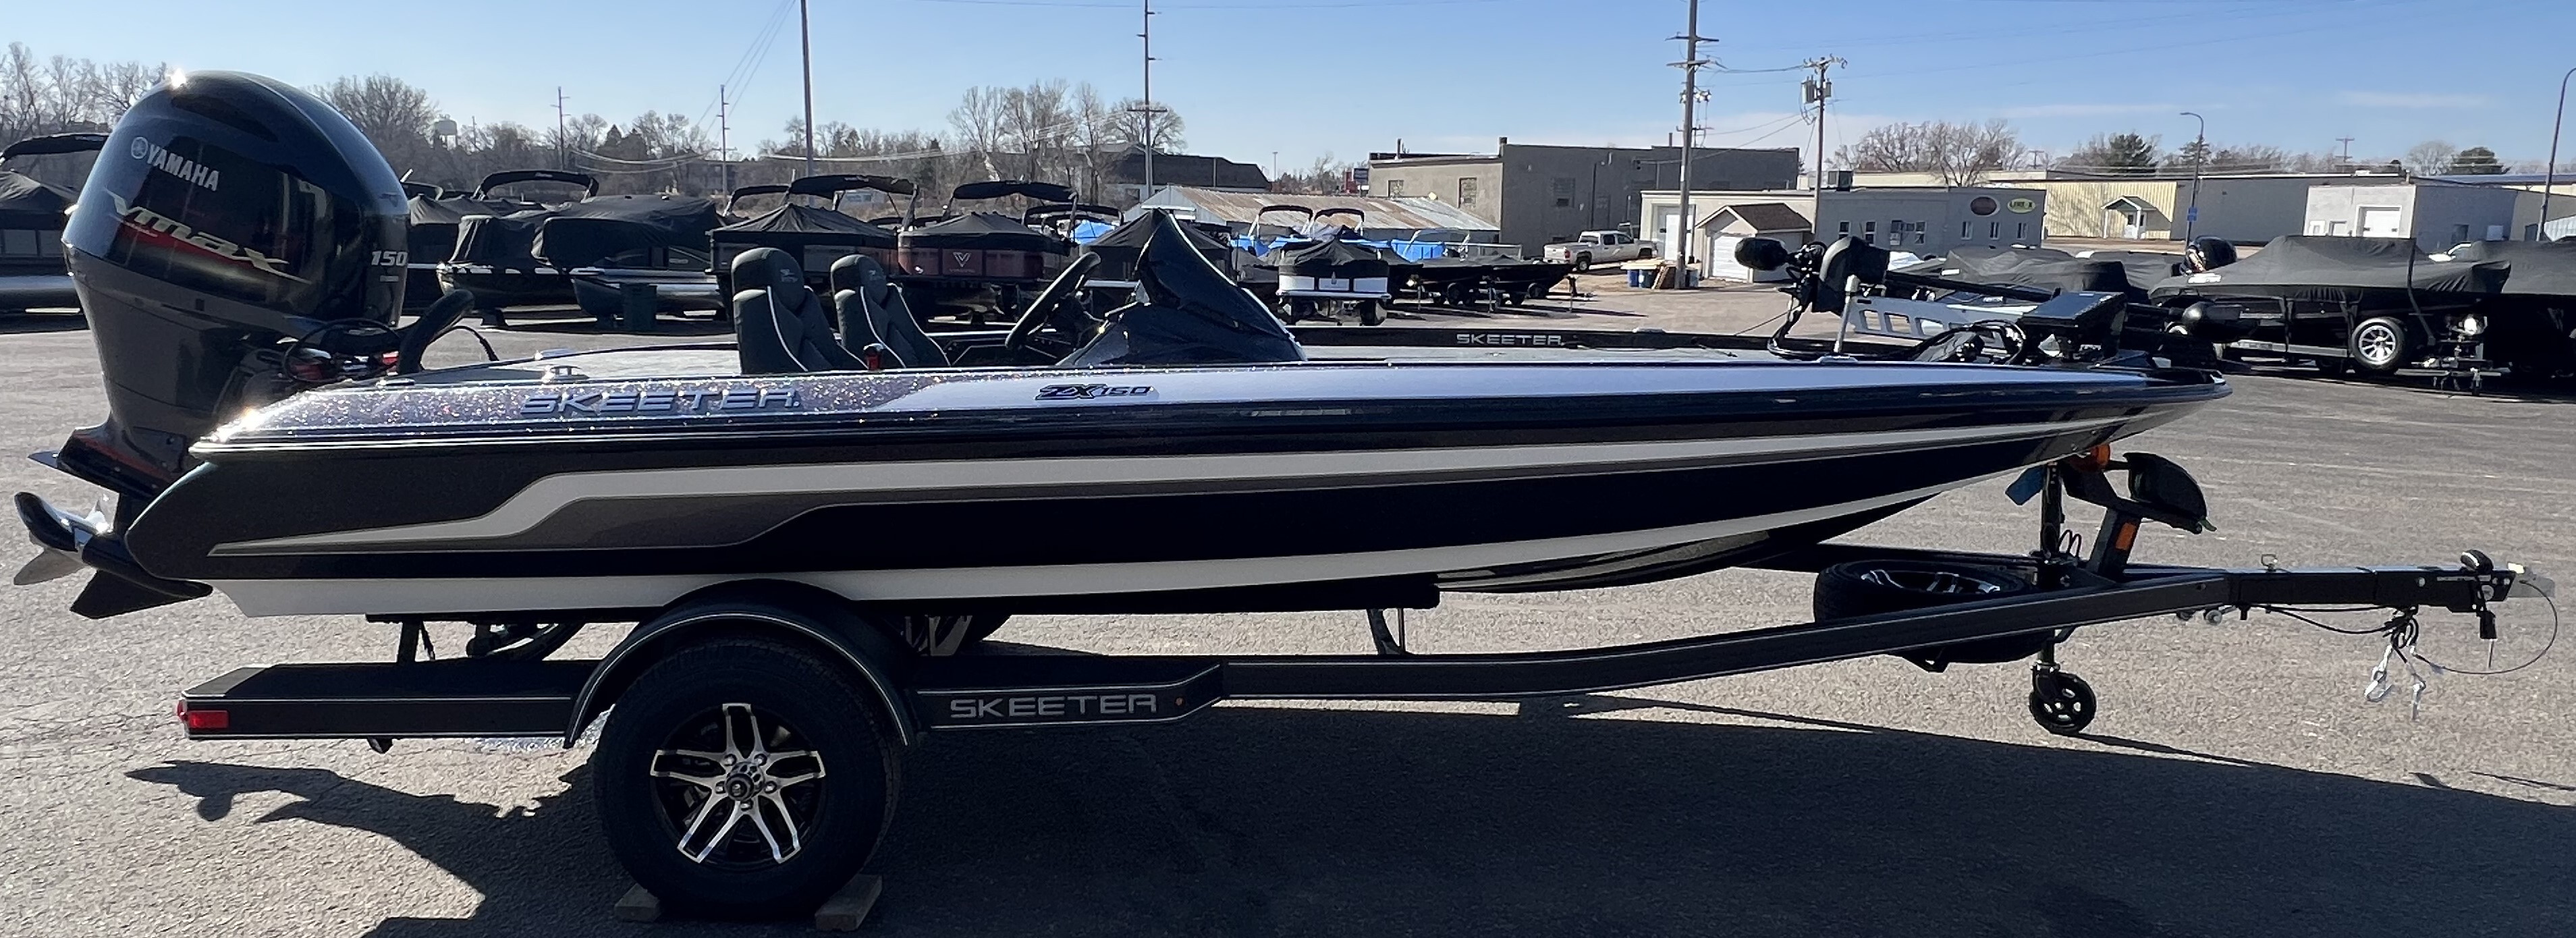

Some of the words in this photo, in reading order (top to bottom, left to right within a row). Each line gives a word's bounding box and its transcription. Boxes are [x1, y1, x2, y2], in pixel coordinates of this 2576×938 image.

[147, 143, 219, 192] YAMAHA
[371, 250, 408, 266] 150
[1456, 333, 1562, 346] SKEETER
[520, 387, 798, 416] SKEETER
[950, 694, 1157, 719] SKEETER
